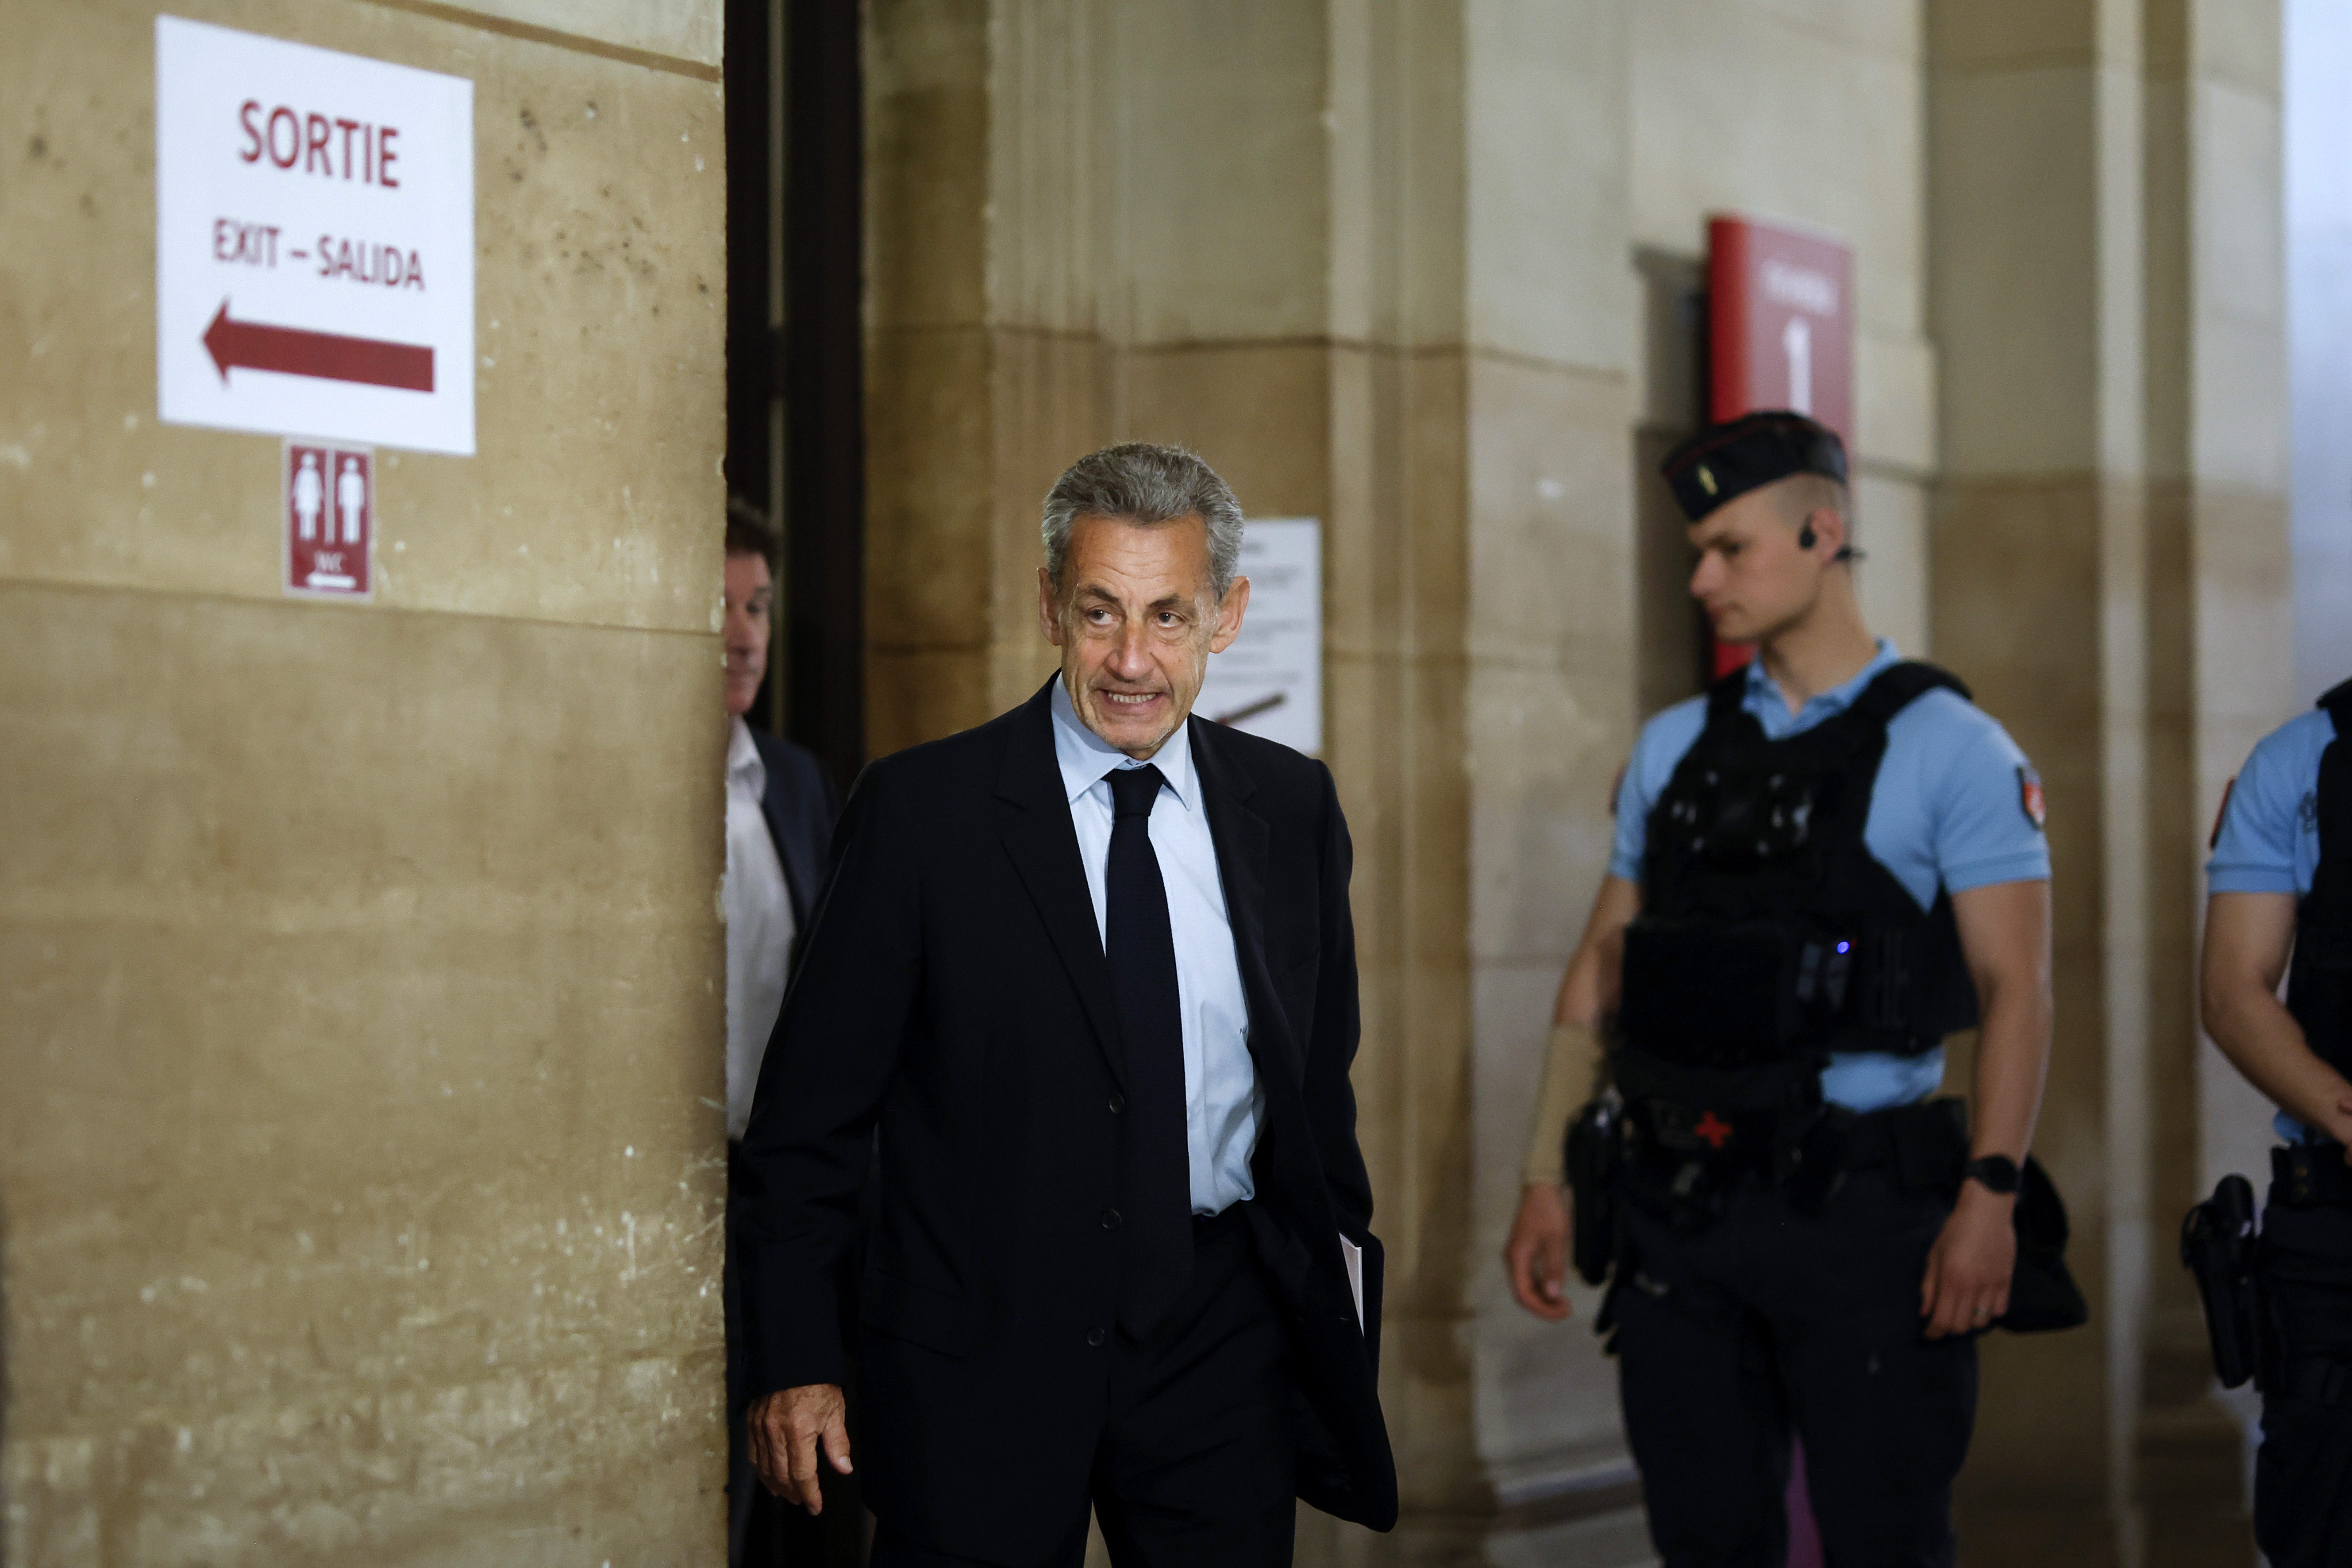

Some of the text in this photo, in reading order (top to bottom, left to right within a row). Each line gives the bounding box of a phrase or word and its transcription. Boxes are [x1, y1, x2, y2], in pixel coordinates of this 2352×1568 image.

[239, 100, 400, 188] SORTIE
[213, 218, 280, 267] EXIT
[318, 235, 425, 290] SALIDA
[314, 550, 346, 572] WC
